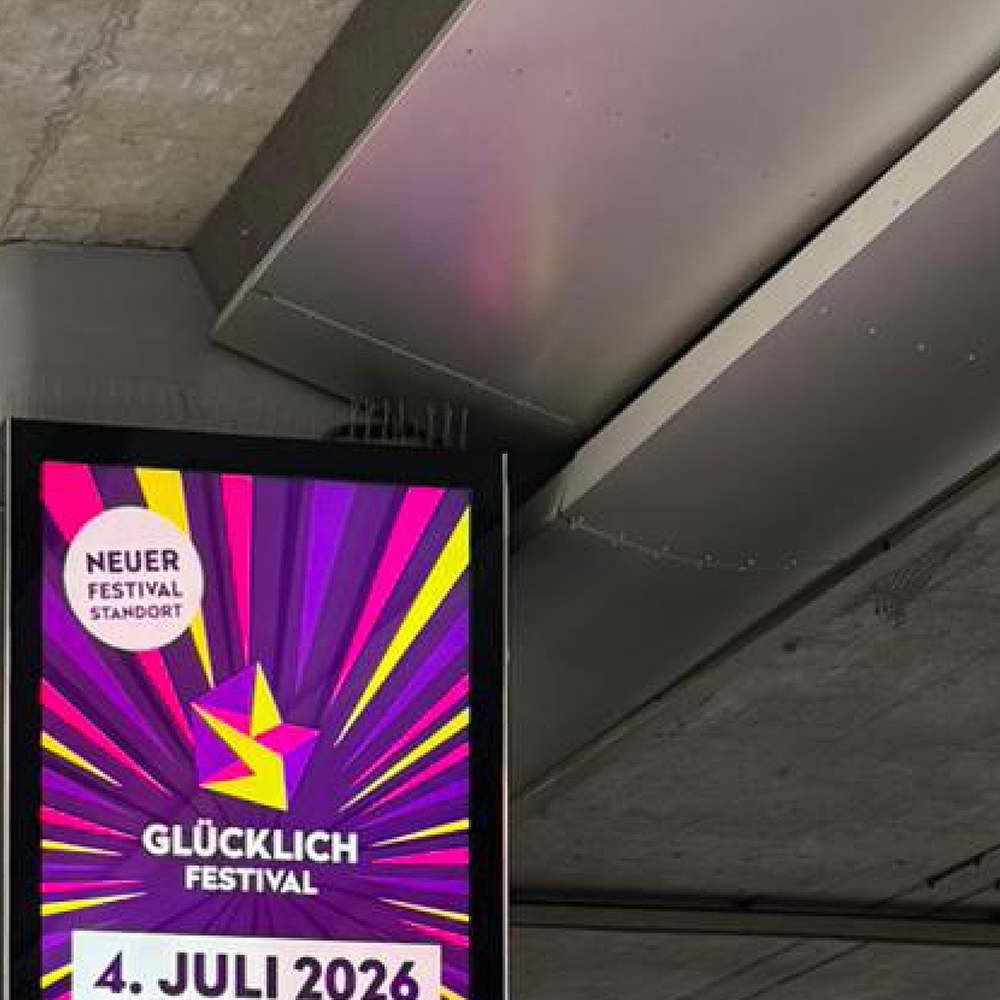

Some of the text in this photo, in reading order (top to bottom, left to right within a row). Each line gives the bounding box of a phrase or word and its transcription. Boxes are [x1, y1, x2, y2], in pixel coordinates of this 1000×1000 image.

[86, 548, 180, 574] NEUER
[87, 580, 183, 599] FESTIVAL
[90, 603, 182, 620] STANDORT
[142, 818, 359, 864] GLÜCKLICH
[184, 865, 319, 895] FESTIVAL
[93, 950, 143, 994] 4.
[158, 951, 278, 999] JULI
